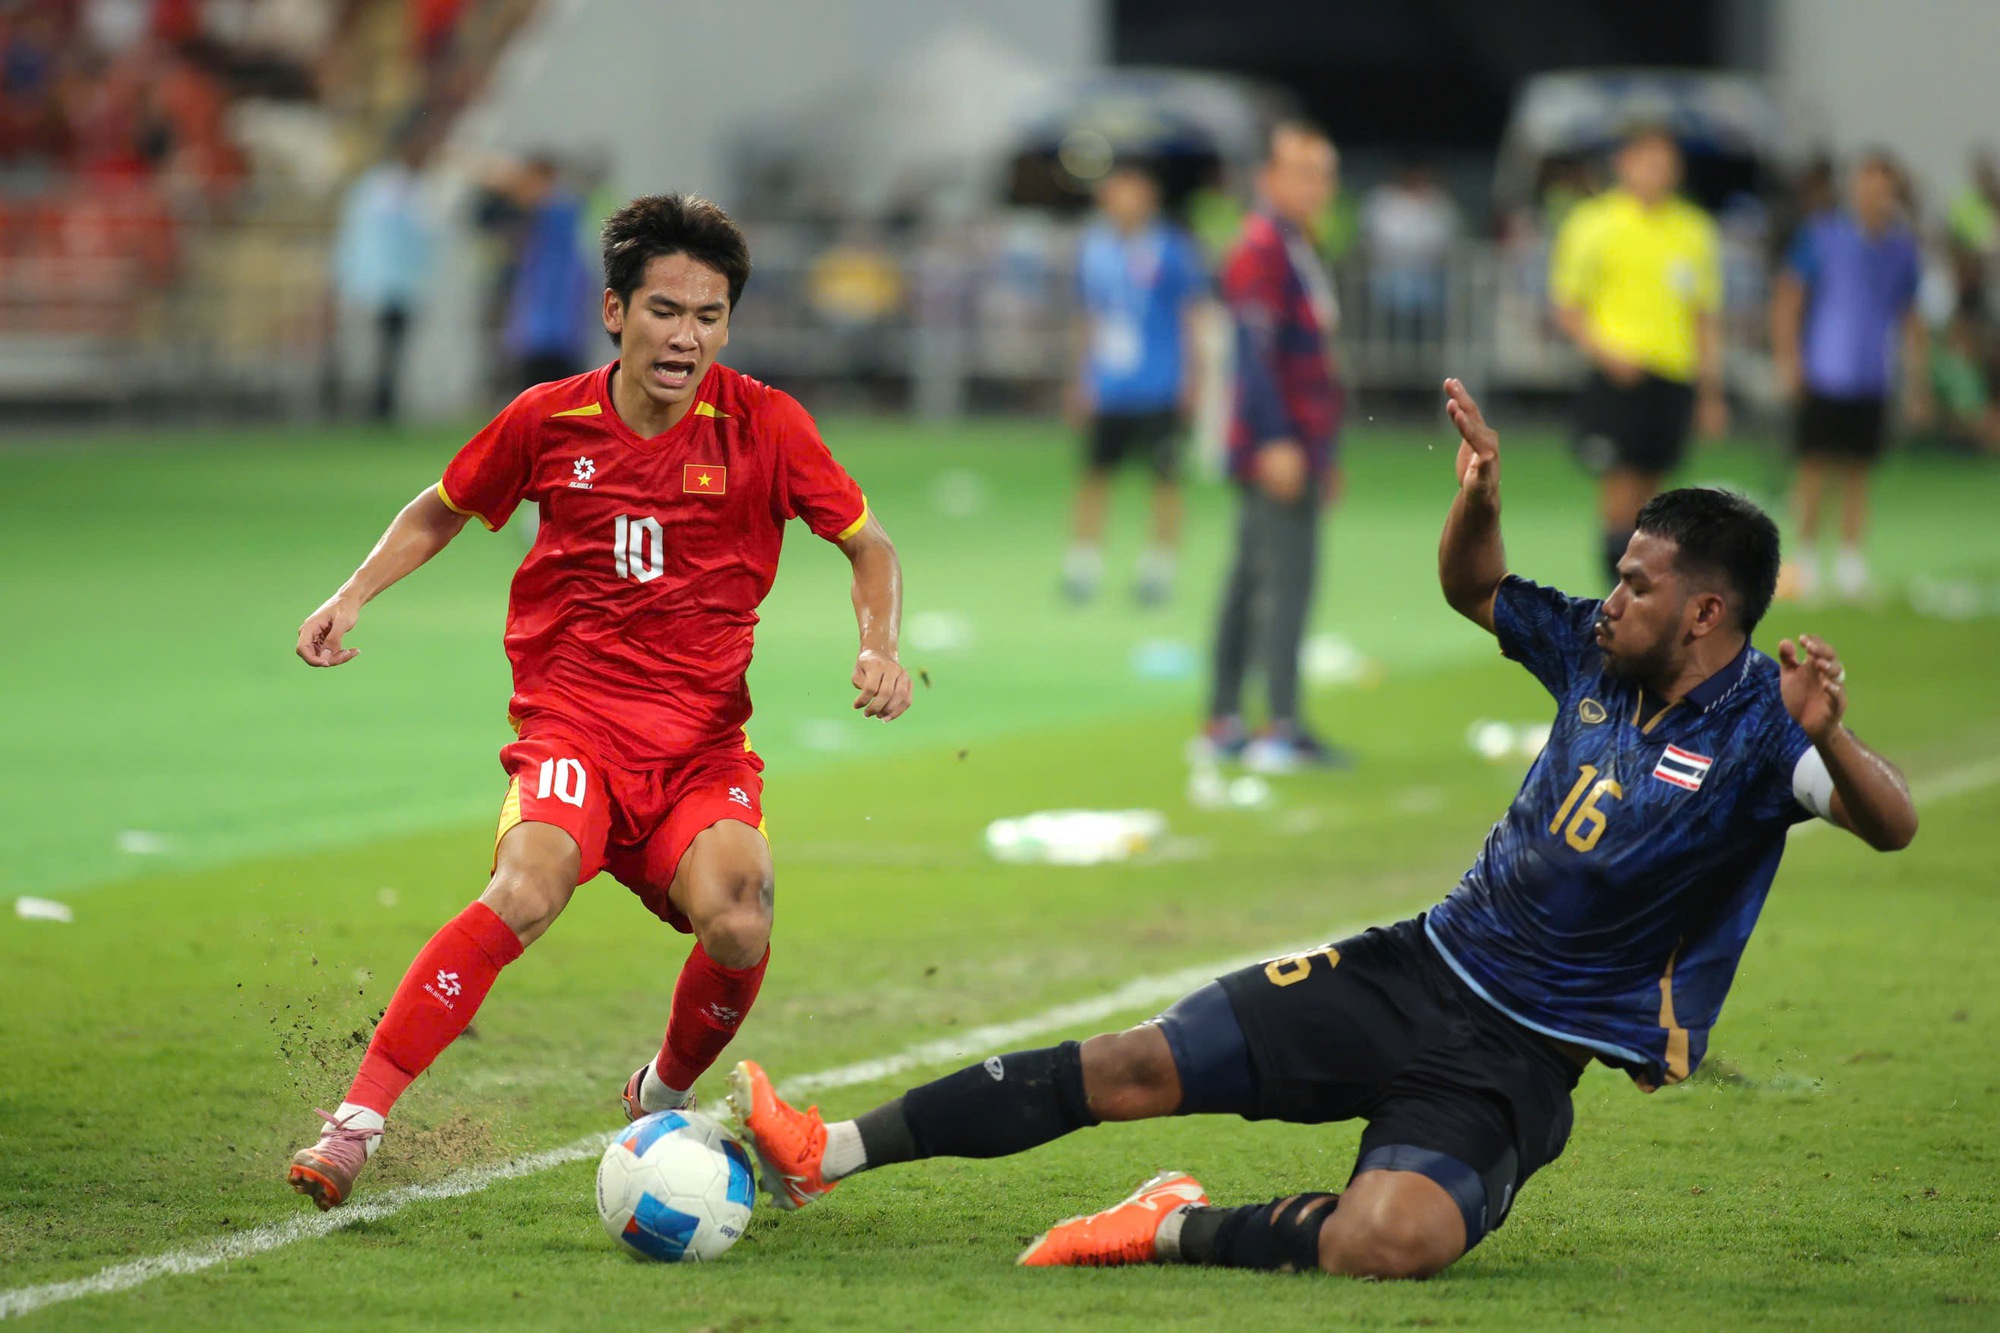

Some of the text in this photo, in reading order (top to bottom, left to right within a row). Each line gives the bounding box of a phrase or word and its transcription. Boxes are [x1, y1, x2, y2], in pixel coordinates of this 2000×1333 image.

[614, 514, 663, 583] 10
[537, 757, 586, 808] 10
[1549, 764, 1622, 852] 16
[1260, 943, 1340, 987] 6
